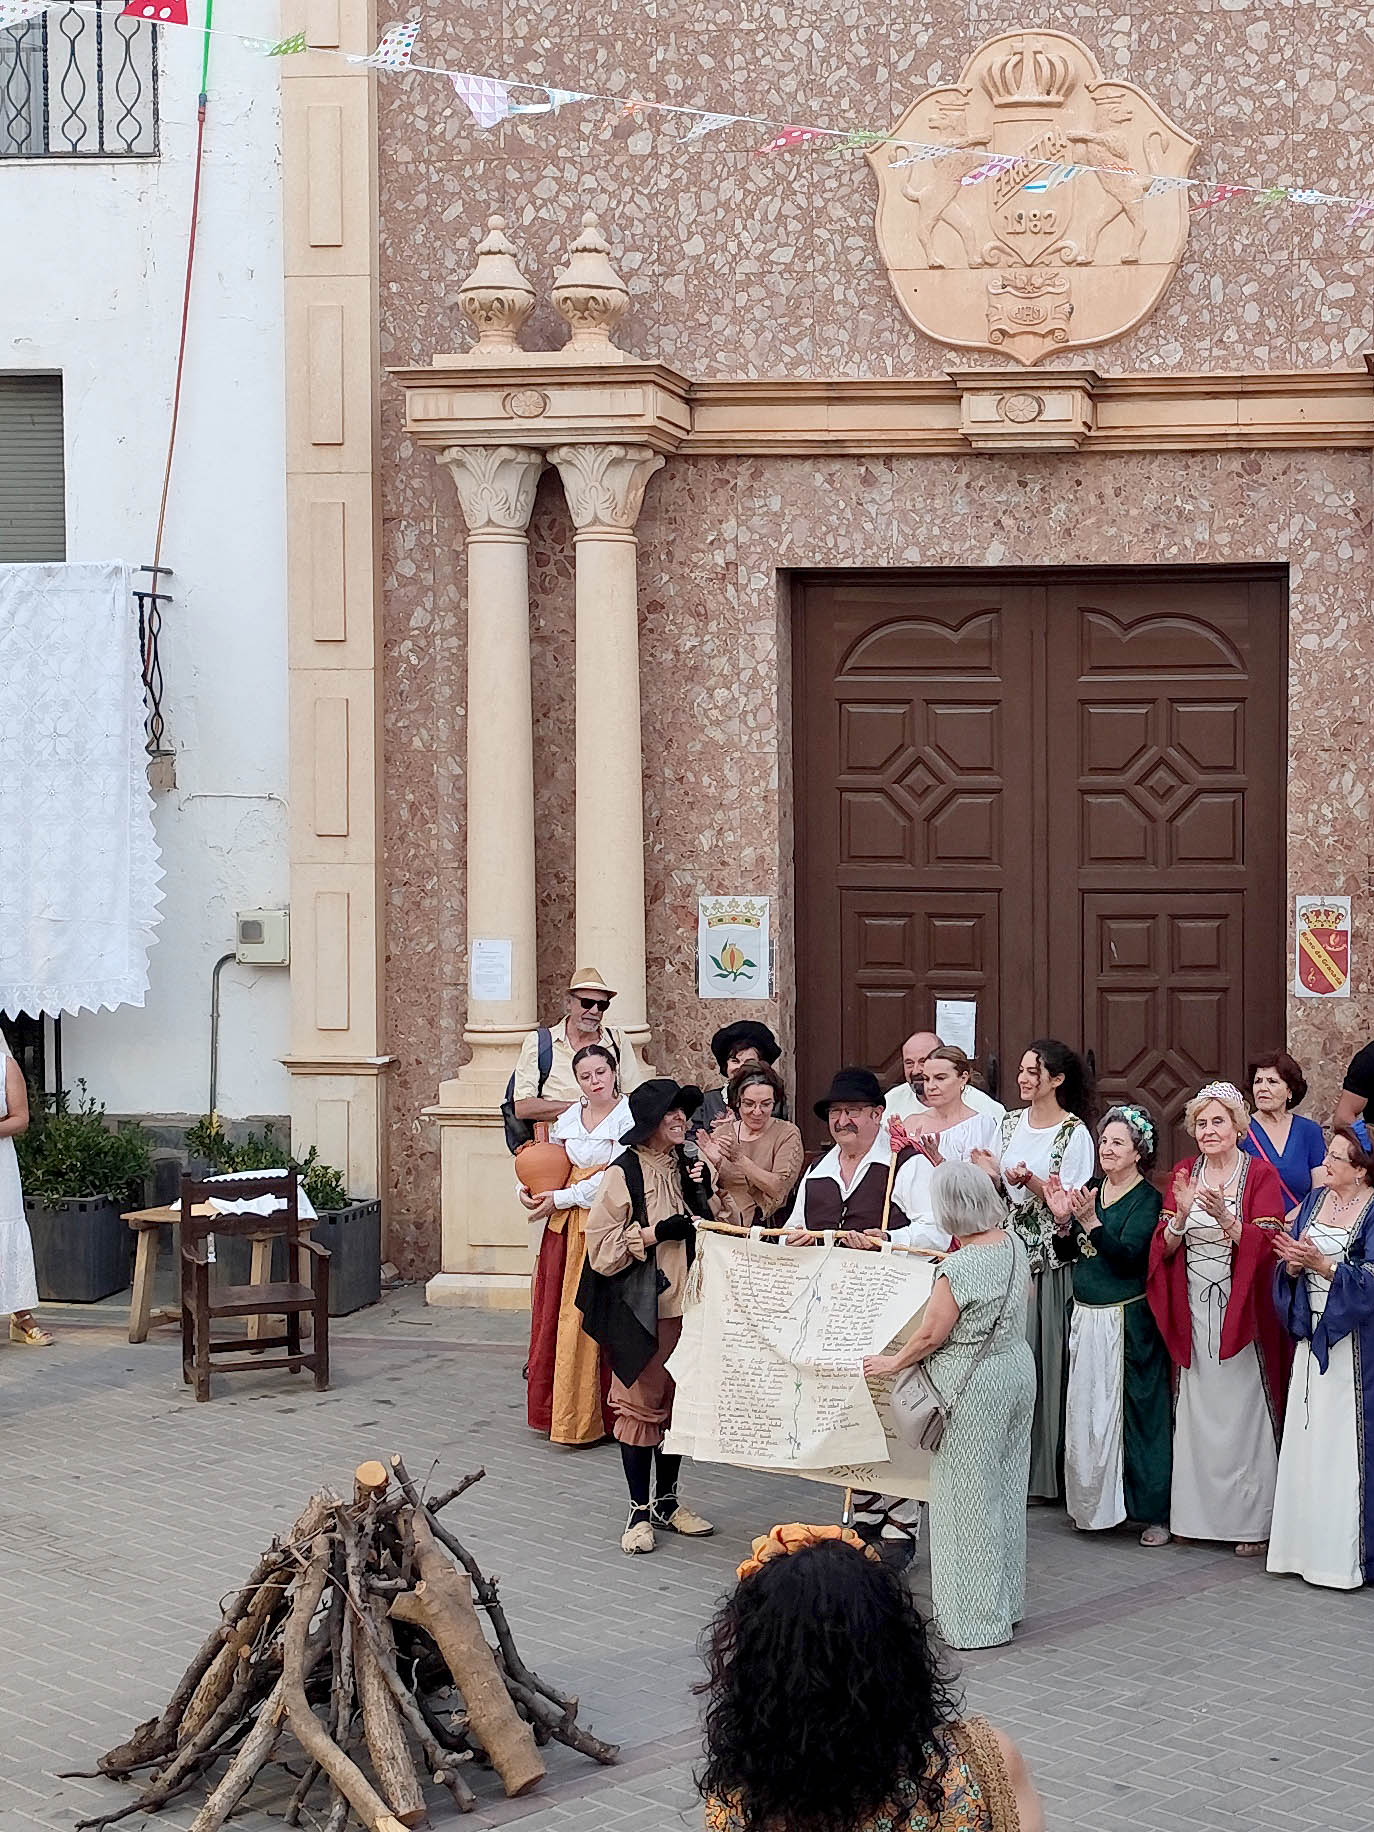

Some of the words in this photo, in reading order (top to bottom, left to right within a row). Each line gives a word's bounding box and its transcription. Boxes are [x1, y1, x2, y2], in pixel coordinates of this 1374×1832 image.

[1003, 210, 1057, 234] 1982
[1301, 931, 1316, 950] Reino
[1314, 950, 1323, 959] de
[1321, 958, 1343, 986] Granada
